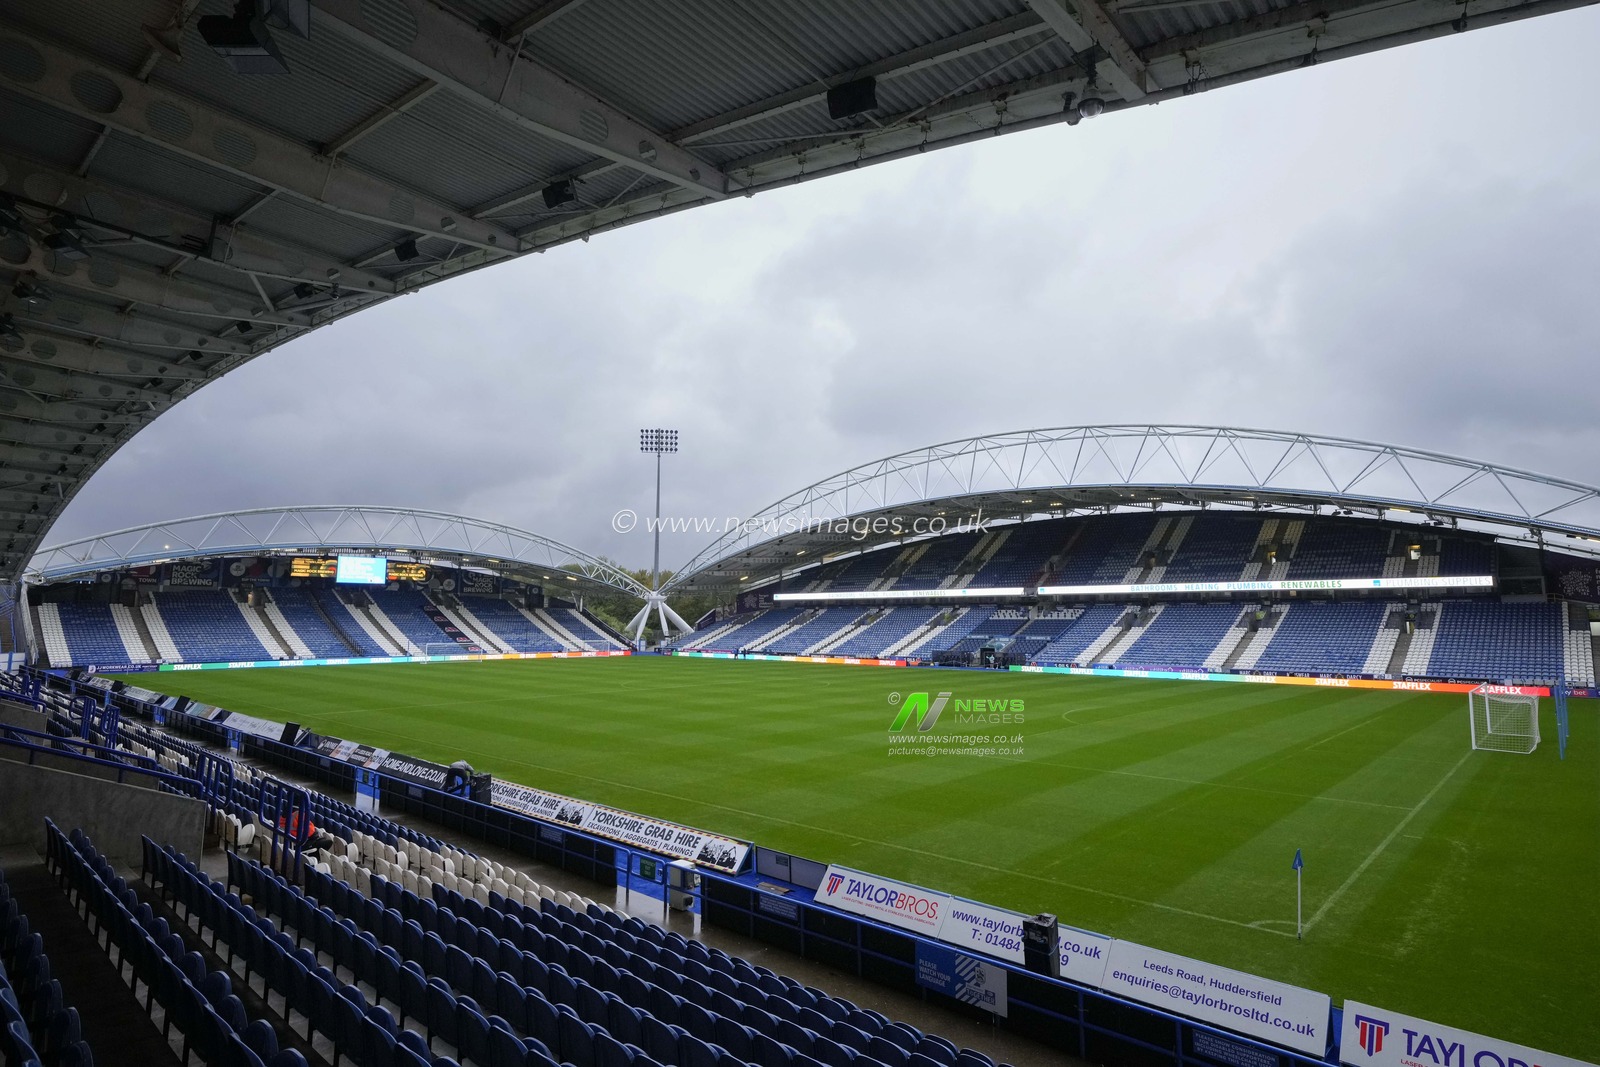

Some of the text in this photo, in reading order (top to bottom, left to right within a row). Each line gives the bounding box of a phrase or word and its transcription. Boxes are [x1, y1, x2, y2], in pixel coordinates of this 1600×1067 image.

[172, 564, 201, 572] MAGIC
[1130, 584, 1178, 592] BATHROOMS
[1280, 580, 1342, 589] RENEWABLES
[1393, 682, 1432, 690] STAFFLEX
[1480, 686, 1522, 694] STAFFLEX
[381, 757, 447, 783] HOMEANDLOVE.CO.UK
[491, 782, 520, 800] ORKSHIRE
[519, 791, 542, 805] GRAB
[541, 797, 561, 811] HIRE
[532, 804, 554, 817] PLANINGS
[592, 810, 701, 848] YORKSHIRE GRAB HIRE
[587, 822, 620, 836] EXCAVATIONS
[663, 843, 694, 857] PLANINGS
[972, 928, 1021, 952] T: 01484
[920, 958, 937, 970] PLEASE
[919, 966, 951, 982] WATCH YOUR
[920, 972, 946, 988] LANGUAGE
[1144, 960, 1282, 1006] Leeds Road, Huddersfield
[1112, 969, 1315, 1038] enquiries@taylorbrosltd.co.uk
[1195, 1033, 1276, 1061] PLEASE SHOW CONSIDERATION
[1195, 1042, 1222, 1054] INCLUDING
[1224, 1051, 1258, 1066] WHEELCHAIR
[1205, 1050, 1226, 1060] KEEPING
[1211, 1042, 1235, 1054] DISABLED
